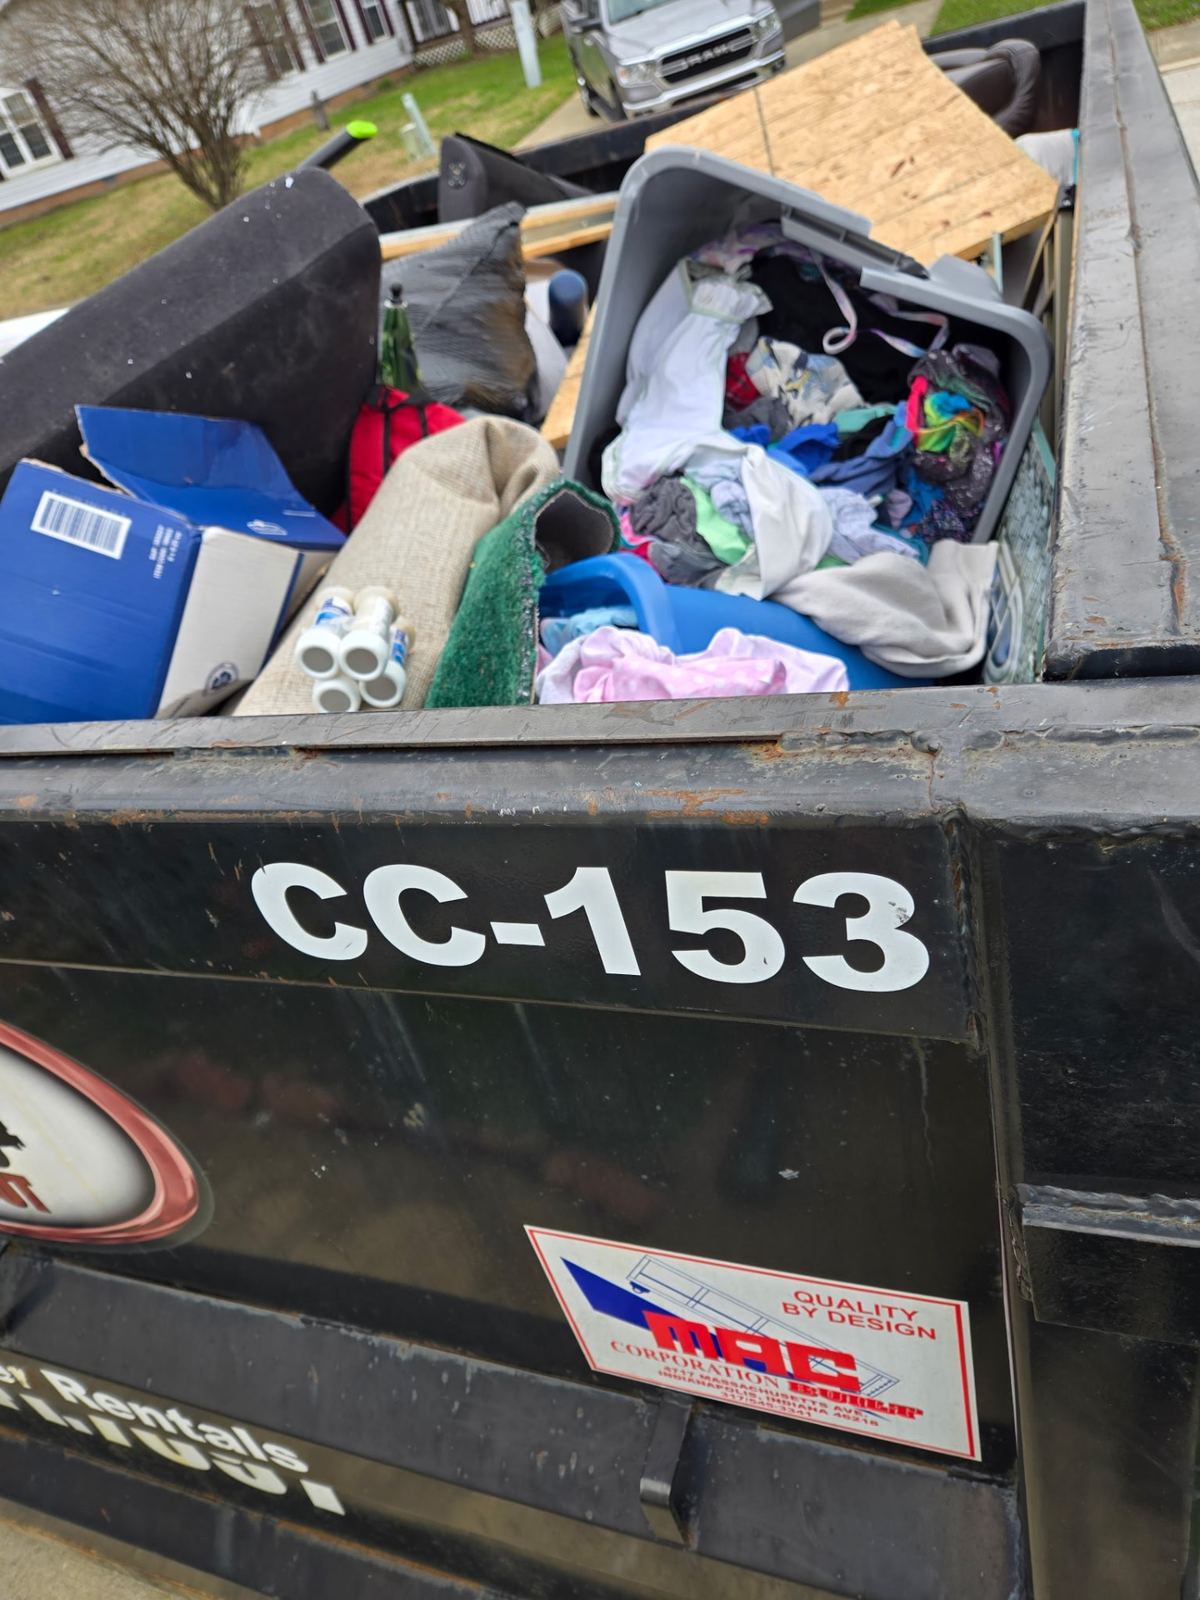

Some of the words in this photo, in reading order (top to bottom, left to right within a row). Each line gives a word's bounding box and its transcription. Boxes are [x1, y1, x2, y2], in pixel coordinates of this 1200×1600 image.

[251, 863, 931, 993] CC-153
[783, 1302, 817, 1318] BY
[827, 1311, 936, 1340] DESIGN
[794, 1291, 917, 1321] QUALITY
[610, 1340, 779, 1388] CORPORATION
[643, 1310, 861, 1393] MAC
[699, 1374, 829, 1409] MASSACHUSETTS
[765, 1395, 829, 1416] INDIANA
[40, 1369, 309, 1473] Rentals
